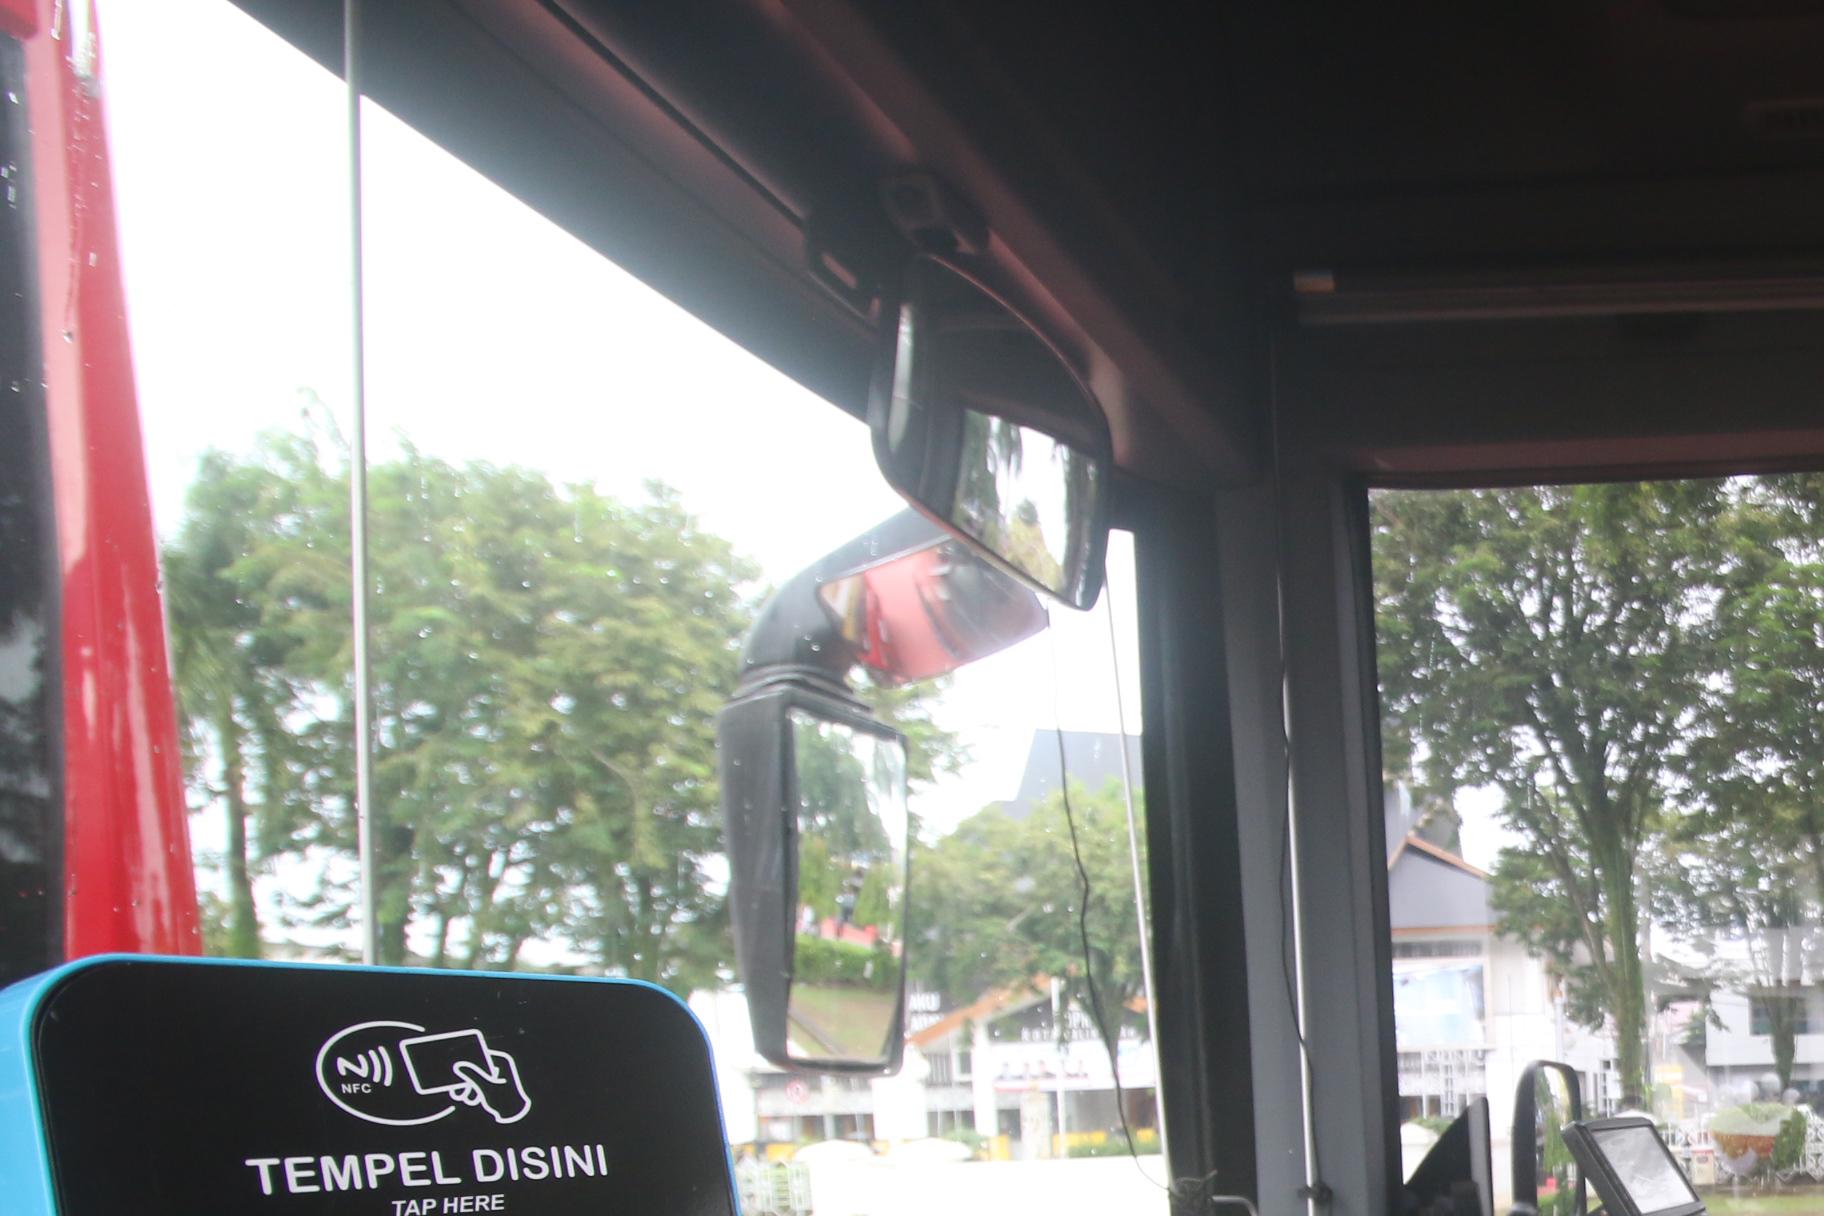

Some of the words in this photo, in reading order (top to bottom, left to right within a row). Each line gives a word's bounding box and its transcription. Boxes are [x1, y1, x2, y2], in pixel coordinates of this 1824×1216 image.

[341, 1082, 372, 1095] NFC
[245, 1150, 462, 1197] TEMPEL
[472, 1143, 608, 1183] DISINI
[443, 1194, 505, 1215] HERE
